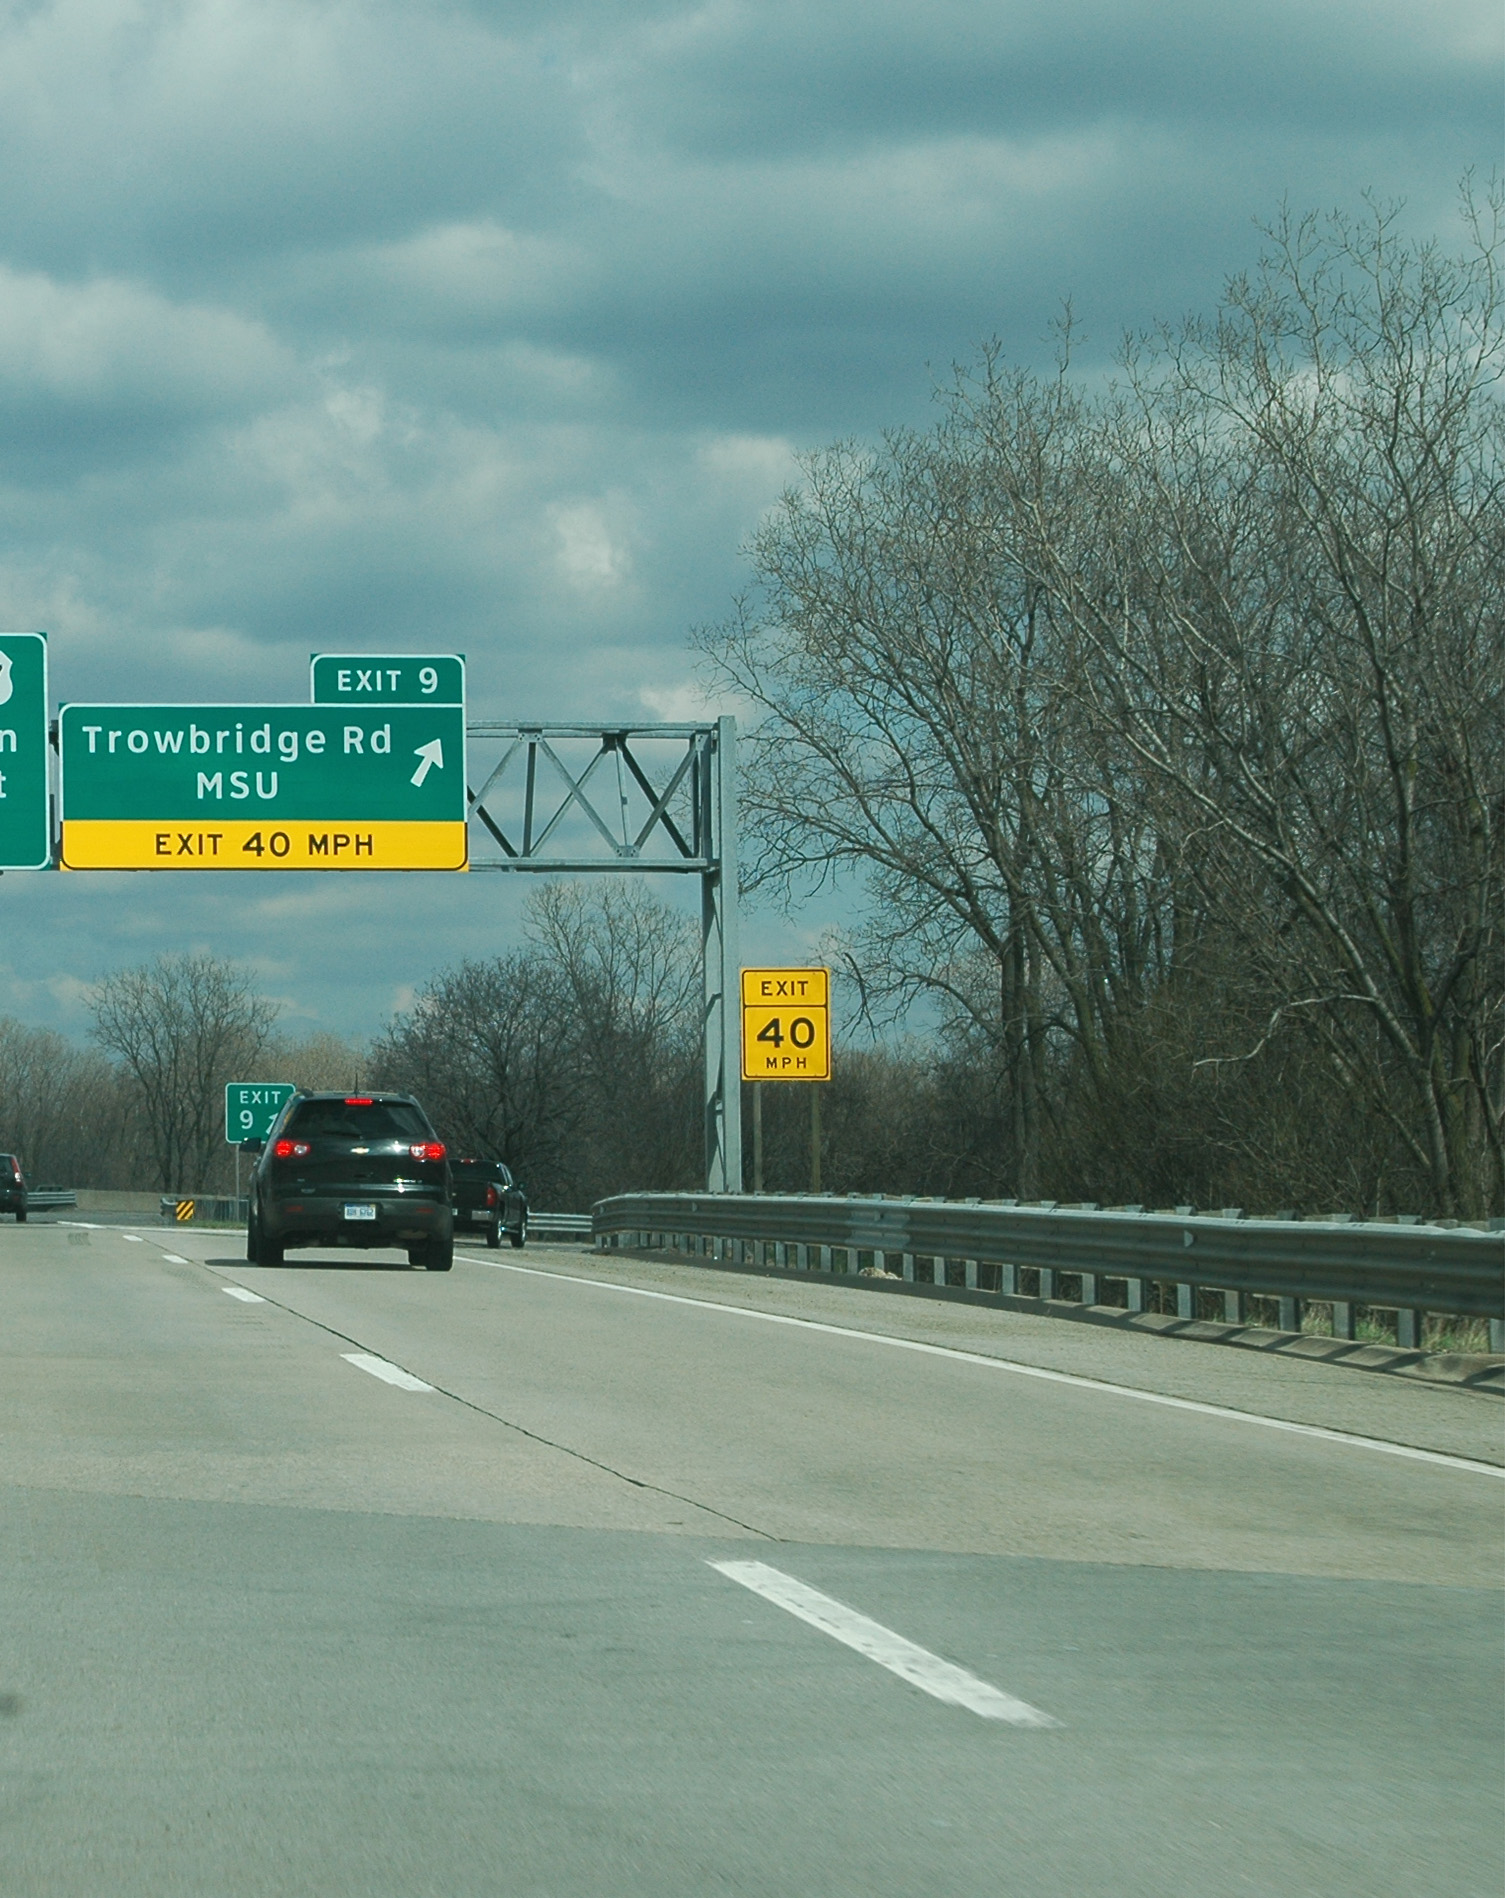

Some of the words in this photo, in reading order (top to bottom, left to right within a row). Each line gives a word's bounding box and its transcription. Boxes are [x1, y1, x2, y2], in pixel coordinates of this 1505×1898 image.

[338, 670, 401, 691] EXIT
[419, 667, 438, 693] 9
[82, 723, 325, 762] Trowbridge
[344, 724, 391, 753] Rd
[198, 772, 278, 799] MSU
[156, 834, 223, 855] EXIT
[243, 832, 291, 857] 40
[309, 834, 373, 855] MPH
[761, 981, 809, 996] EXIT
[757, 1017, 815, 1049] 40
[766, 1057, 807, 1069] MPH
[240, 1091, 281, 1104] EXIT
[240, 1110, 254, 1130] 9
